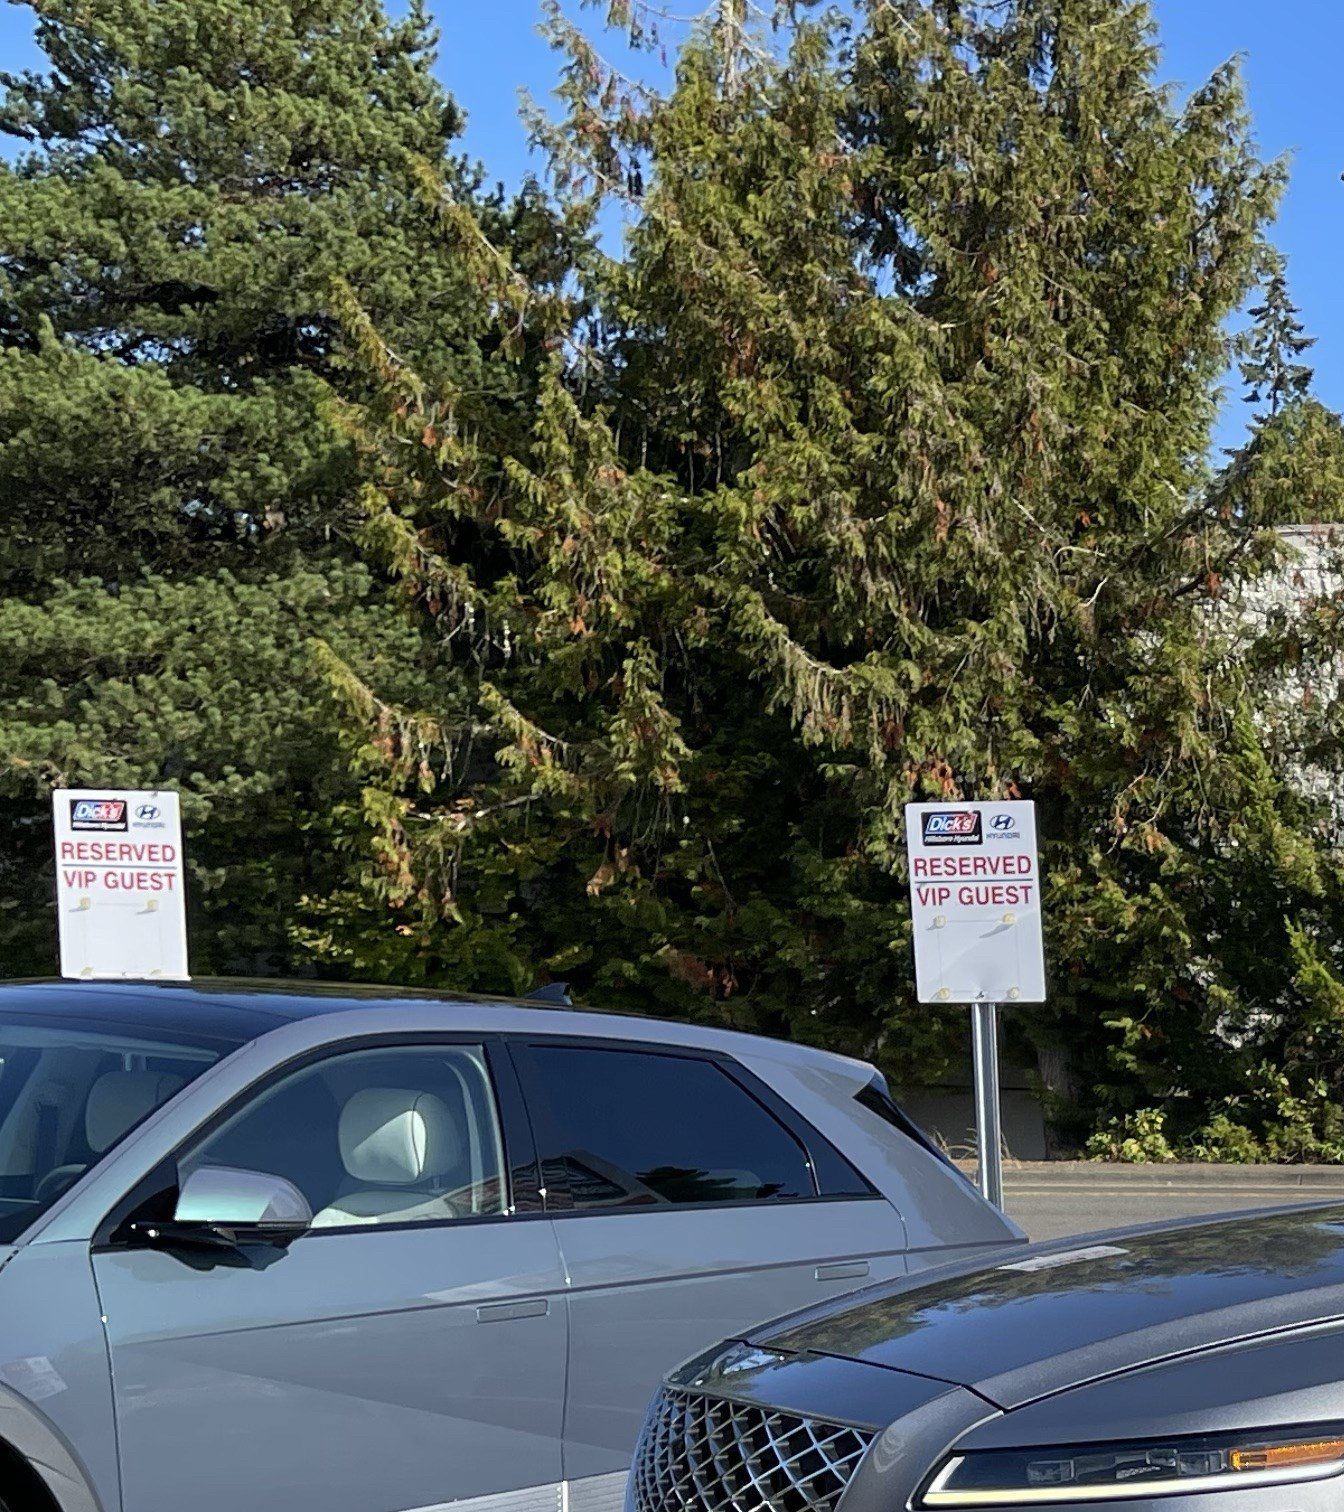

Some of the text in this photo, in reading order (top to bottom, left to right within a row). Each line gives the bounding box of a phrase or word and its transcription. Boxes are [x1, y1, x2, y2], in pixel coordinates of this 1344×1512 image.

[61, 841, 176, 863] RESERVED
[914, 855, 1033, 877] RESERVED
[64, 870, 176, 892] VIP GUEST
[917, 885, 1033, 906] VIP GUEST
